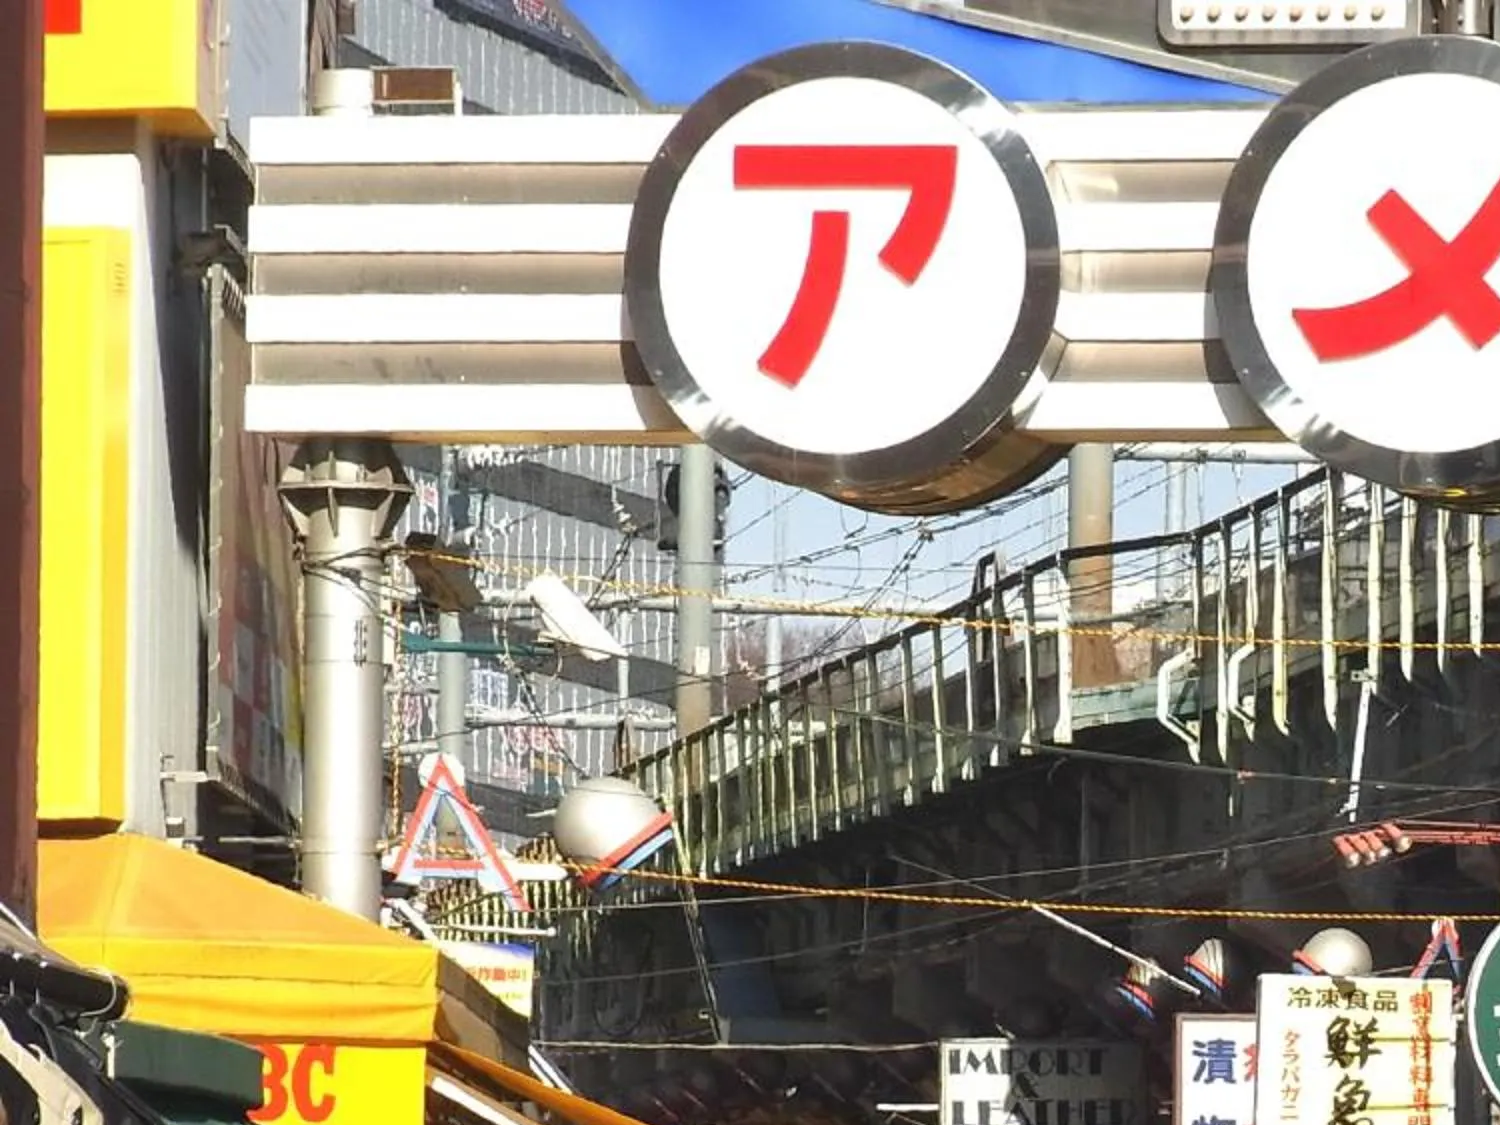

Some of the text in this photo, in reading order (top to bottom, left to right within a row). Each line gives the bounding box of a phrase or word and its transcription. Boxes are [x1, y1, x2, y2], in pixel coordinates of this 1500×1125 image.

[1287, 986, 1398, 1012] 冷凍食品
[950, 1048, 1108, 1076] IMPORT
[1280, 1028, 1301, 1121] タラバガニ
